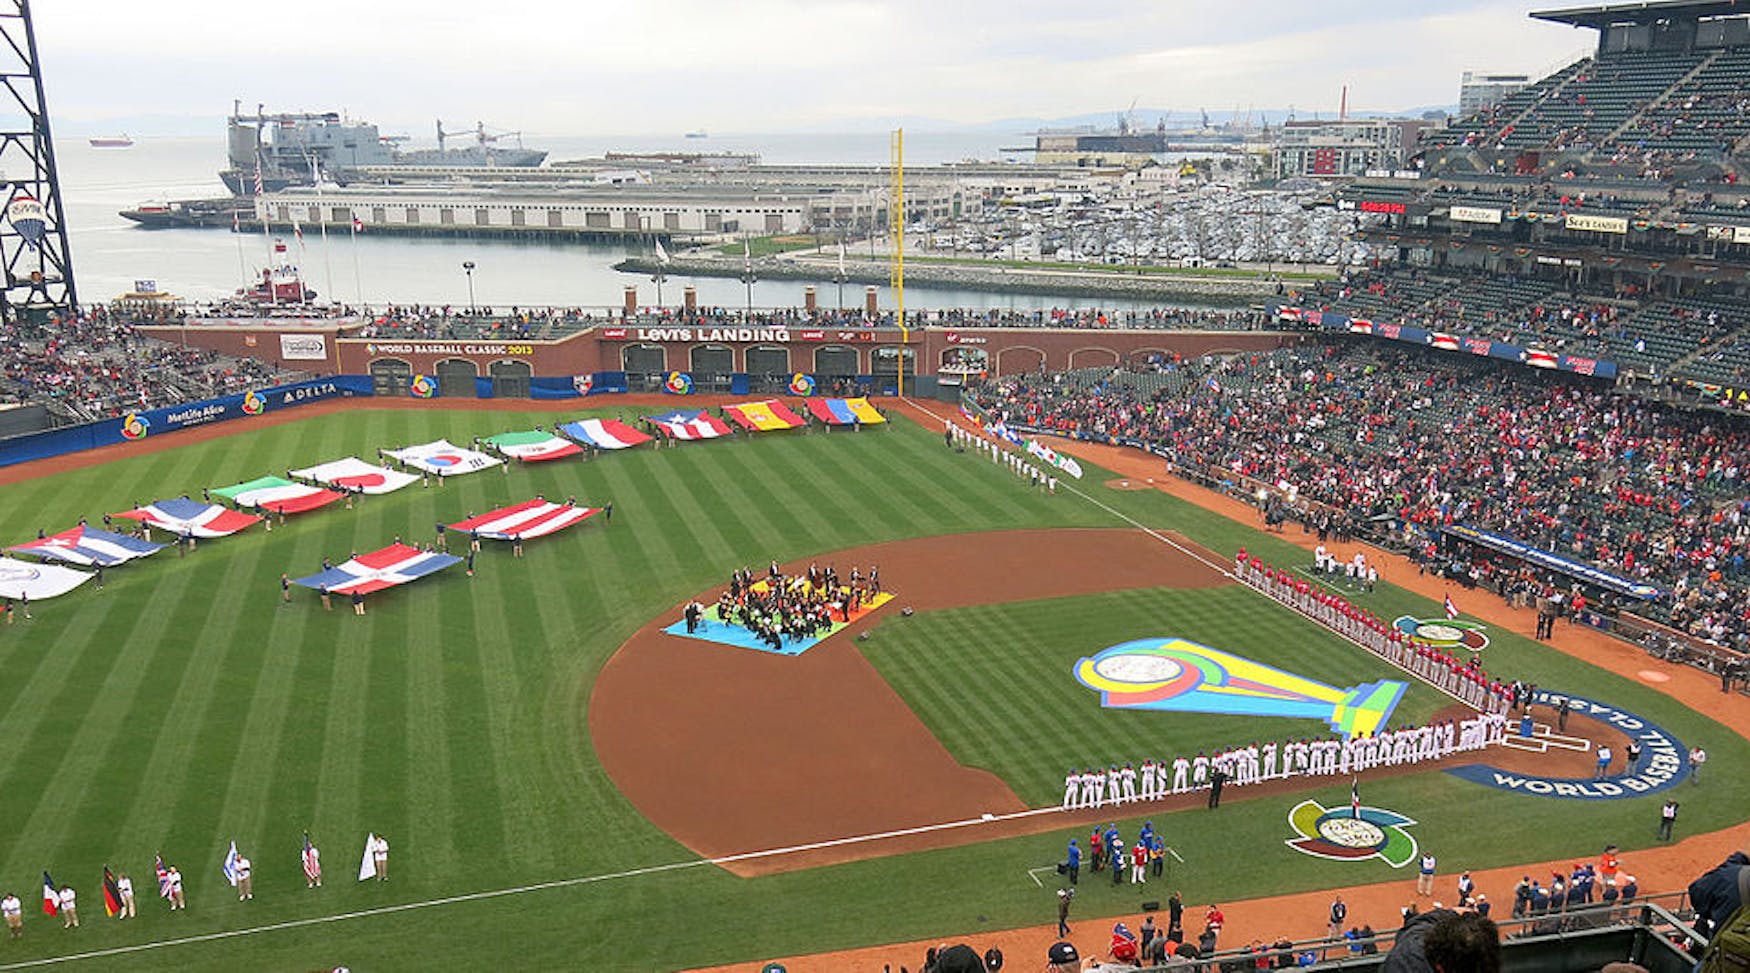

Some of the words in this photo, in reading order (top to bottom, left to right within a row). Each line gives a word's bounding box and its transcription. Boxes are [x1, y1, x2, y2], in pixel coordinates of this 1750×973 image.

[697, 328, 791, 342] LANDING
[377, 344, 413, 354] WORLD
[415, 344, 463, 354] BASEBALL
[464, 345, 506, 355] CLASSIC
[508, 345, 534, 355] 2013
[296, 383, 337, 400] DELTA
[167, 409, 202, 424] MetLife
[1493, 772, 1623, 796] WORLD
[1620, 729, 1681, 792] BASEBALL
